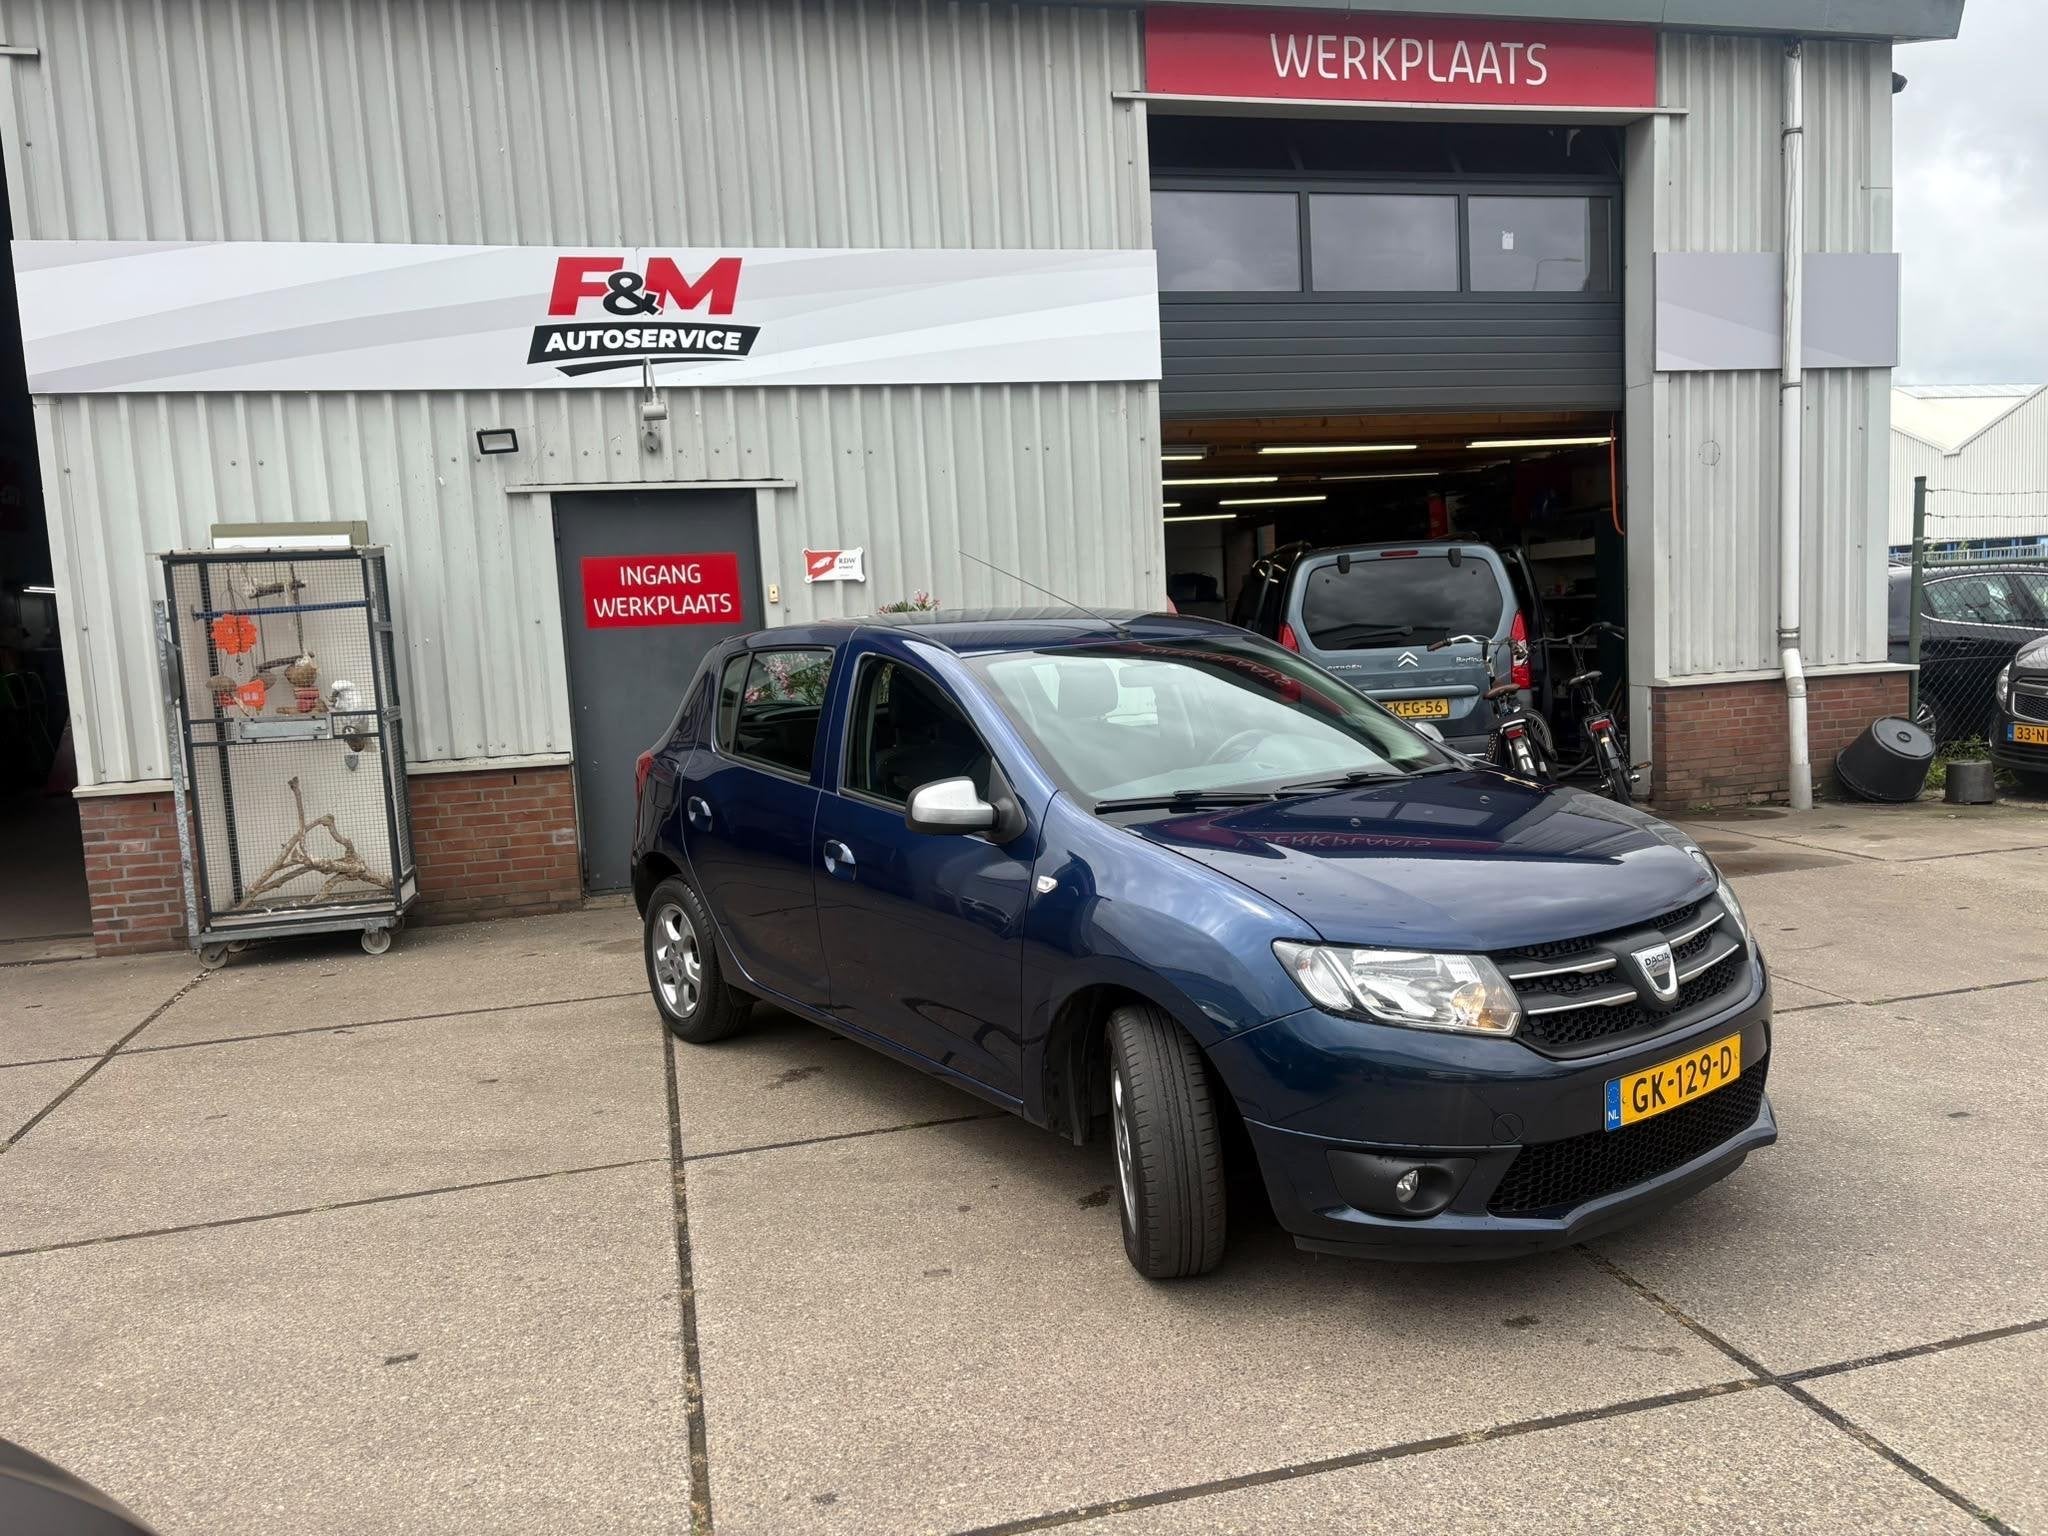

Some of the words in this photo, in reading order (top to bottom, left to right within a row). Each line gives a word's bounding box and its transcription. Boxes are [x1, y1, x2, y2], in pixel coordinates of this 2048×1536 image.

[1269, 33, 1548, 86] WERKPLAATS
[547, 256, 743, 316] F&M
[544, 328, 742, 353] AUTOSERVICE
[620, 564, 701, 586] INGANG
[593, 593, 732, 618] WERKPLAATS
[1383, 701, 1443, 715] -KFG-56
[2016, 726, 2048, 742] 33-N
[1645, 952, 1671, 966] DACIA
[1632, 1045, 1732, 1113] GK-129-D
[1608, 1109, 1619, 1121] NL
